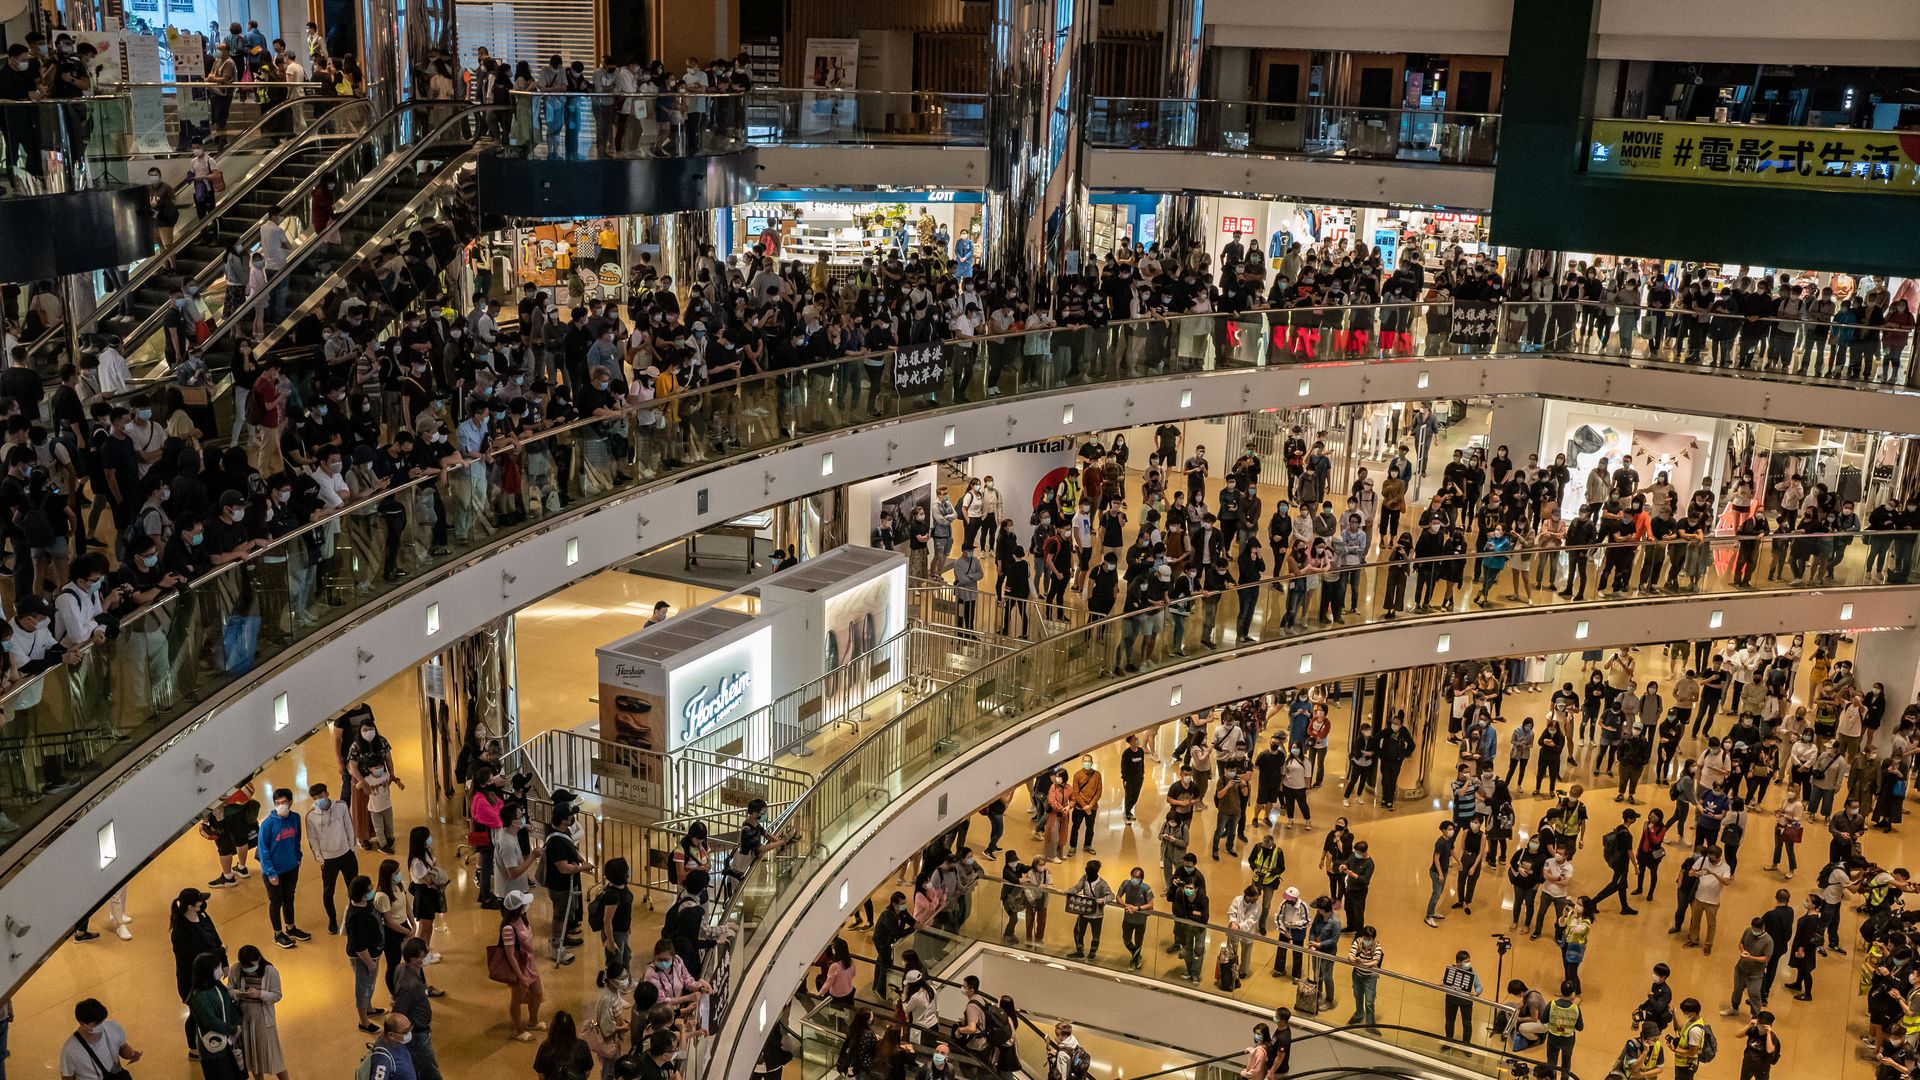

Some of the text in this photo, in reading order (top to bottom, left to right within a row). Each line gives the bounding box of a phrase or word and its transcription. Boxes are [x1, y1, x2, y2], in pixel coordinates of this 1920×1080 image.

[1622, 131, 1664, 145] MOVIE
[1620, 145, 1662, 159] MOVIE
[898, 345, 943, 368] 光復香港
[896, 364, 944, 388] 時代革命
[615, 663, 646, 677] Florsheim
[681, 671, 752, 741] Florsheim
